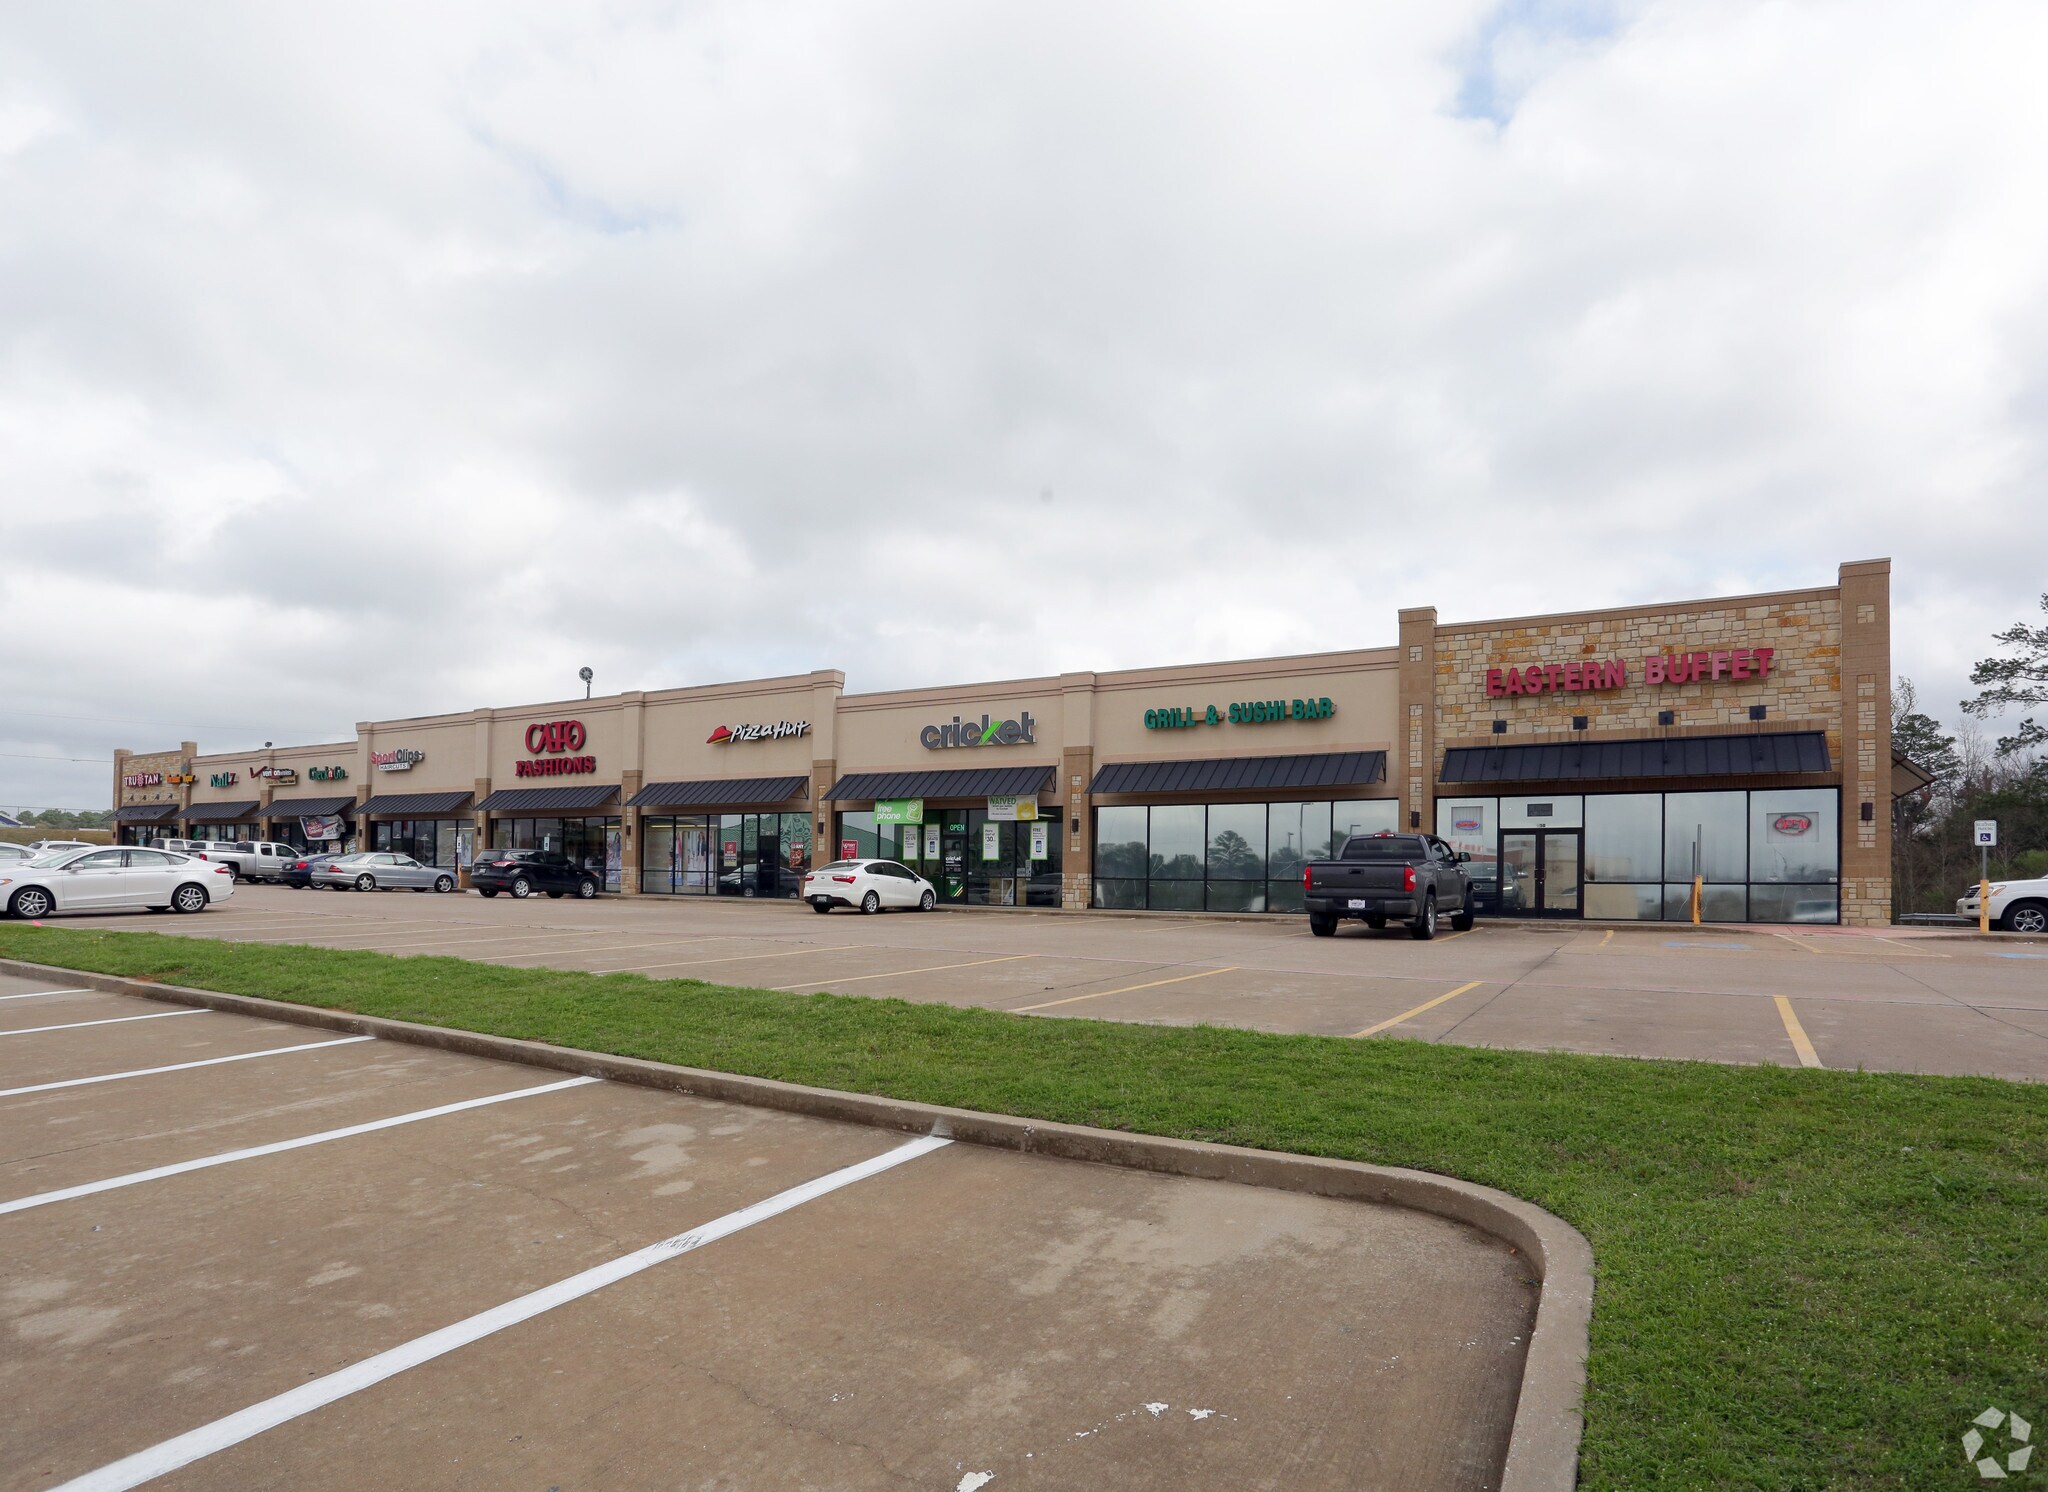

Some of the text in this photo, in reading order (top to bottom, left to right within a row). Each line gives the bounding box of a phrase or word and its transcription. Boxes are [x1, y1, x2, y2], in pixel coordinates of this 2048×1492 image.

[1486, 647, 1775, 697] EASTERN BUFFET
[1144, 697, 1334, 730] GRILL & SUSHI BAR
[525, 720, 587, 755] CATO
[730, 720, 812, 743] Pizza Hut
[920, 711, 1037, 750] cricket
[515, 756, 597, 778] FASHIONS
[124, 776, 137, 786] TRU
[144, 773, 159, 785] TAN
[877, 812, 901, 822] phone
[1776, 818, 1809, 830] OPEN
